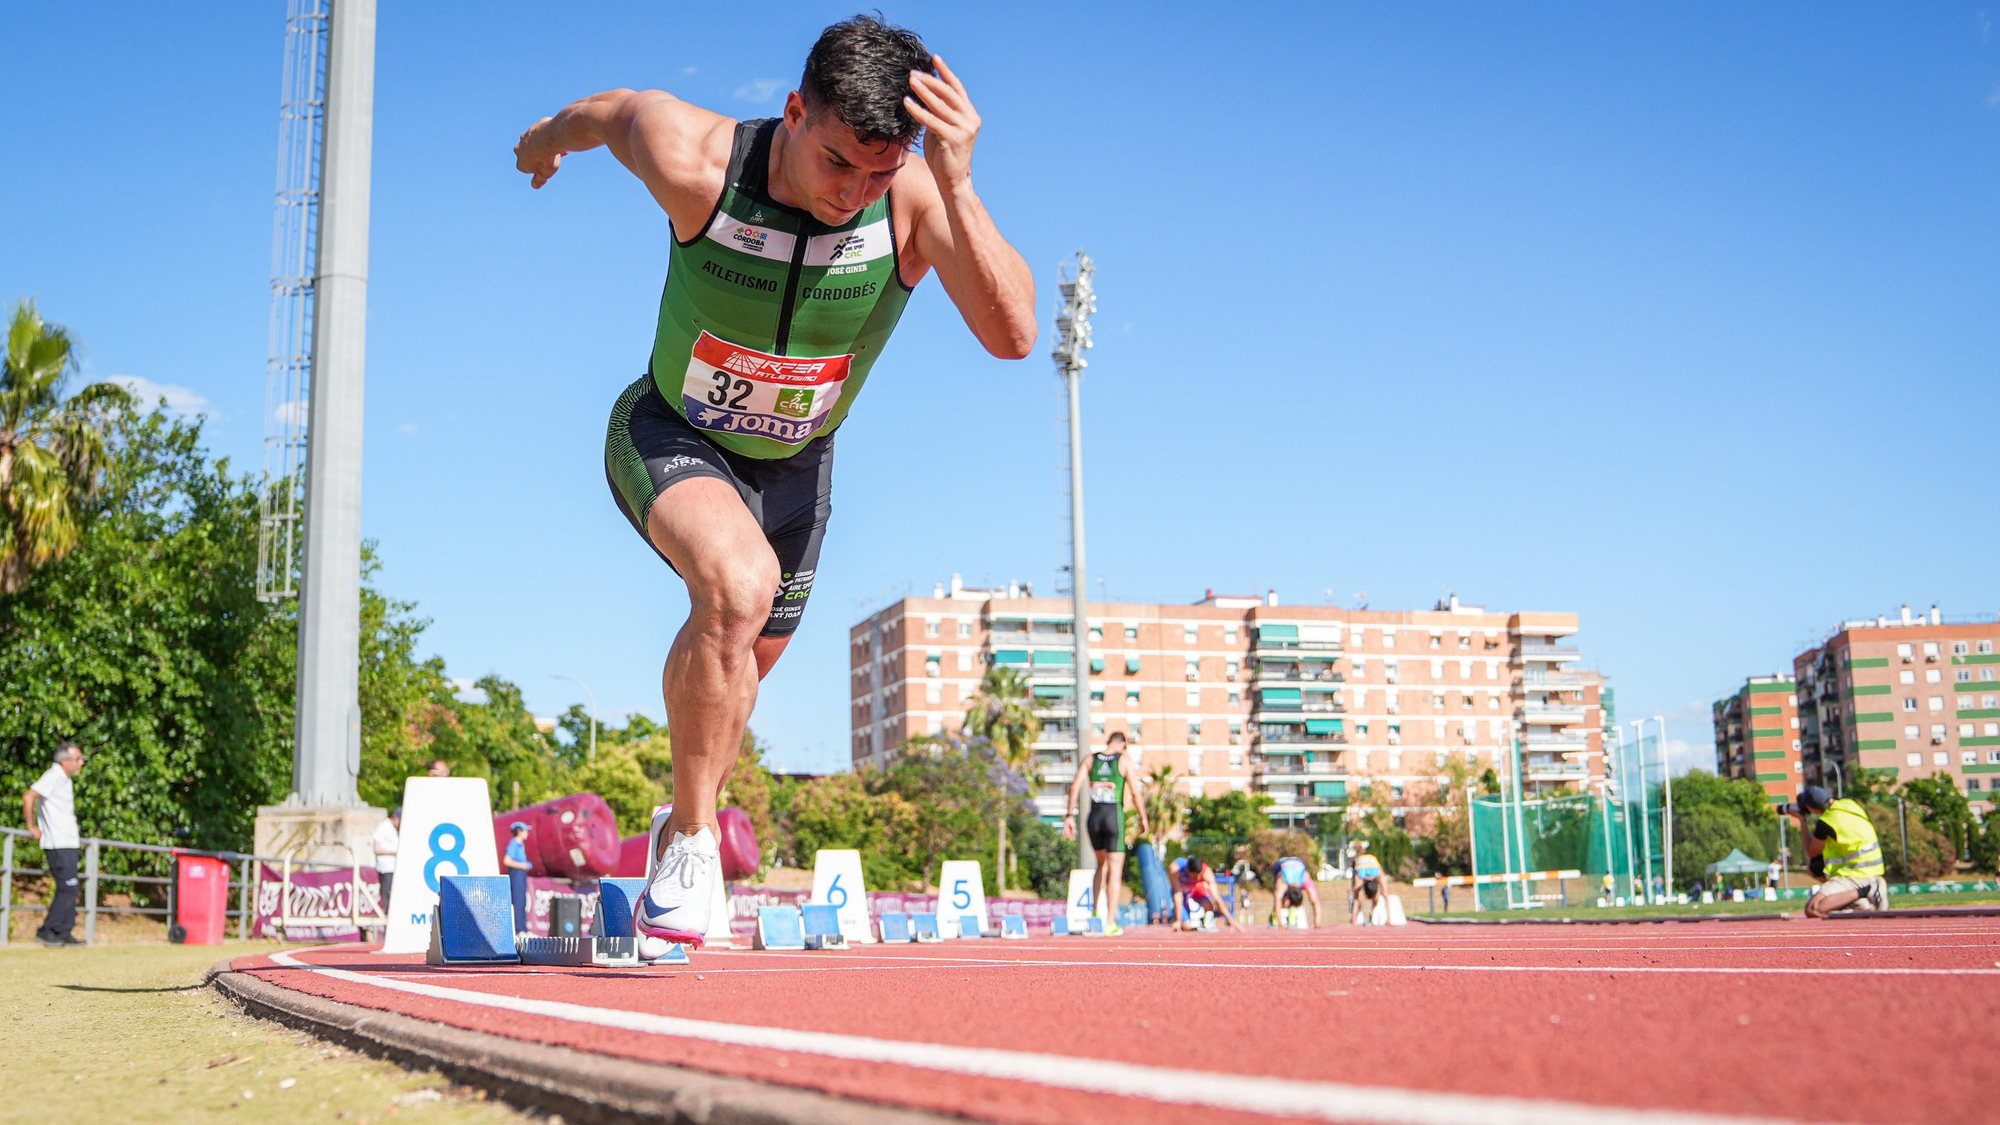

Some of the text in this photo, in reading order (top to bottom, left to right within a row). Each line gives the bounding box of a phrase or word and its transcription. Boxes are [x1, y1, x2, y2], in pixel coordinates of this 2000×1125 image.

[733, 233, 765, 247] CÓRDOBA
[844, 250, 862, 259] CAC
[845, 264, 868, 275] GINER
[702, 260, 877, 300] ATLETISMO CORDOBÉS
[761, 360, 827, 374] RFEA
[755, 371, 817, 382] ATLETISMO
[707, 370, 754, 411] 32
[780, 401, 808, 411] CAC
[785, 588, 810, 600] CAC
[423, 823, 470, 894] 8
[827, 873, 847, 909] 6
[953, 880, 971, 909] 5
[1076, 887, 1094, 911] 4
